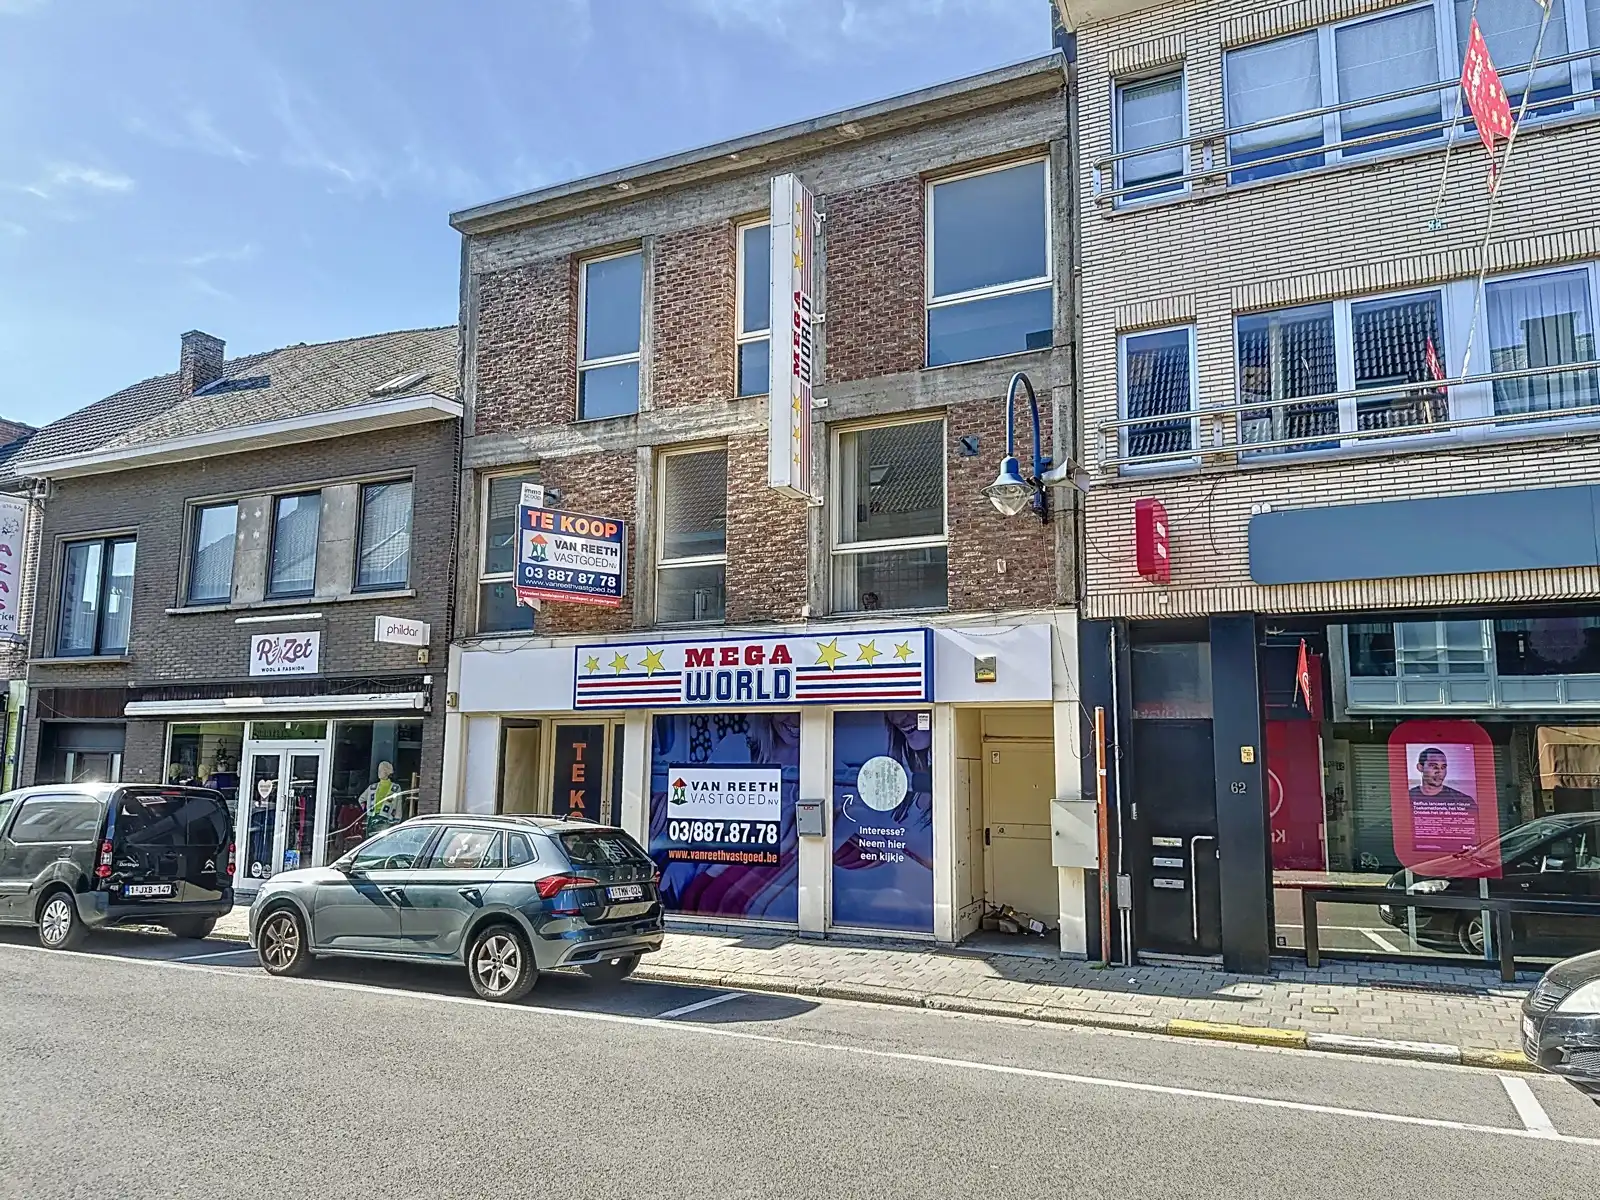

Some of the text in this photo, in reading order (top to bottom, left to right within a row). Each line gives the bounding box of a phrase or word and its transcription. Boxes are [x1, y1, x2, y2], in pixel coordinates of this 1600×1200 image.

[793, 291, 801, 378] MEGA
[801, 296, 812, 384] WORLD
[528, 510, 618, 538] TE KOOP
[554, 540, 618, 556] VAN REETH
[554, 552, 608, 568] VASTGOED
[525, 566, 616, 587] 03 887 87 78
[524, 579, 616, 594] www.vanreethvastgoed.be
[386, 624, 418, 636] phildar
[684, 644, 792, 668] MEGA
[684, 667, 792, 703] WORLD
[691, 781, 778, 792] VAN REETH
[1230, 782, 1247, 794] 62
[690, 793, 766, 805] VASTGOED
[669, 821, 778, 844] 03/887.87.78
[859, 826, 906, 836] Interesse?
[859, 839, 906, 849] Neem hier
[668, 850, 778, 863] www.vanreethvastgoed.be
[880, 852, 905, 863] kijkje
